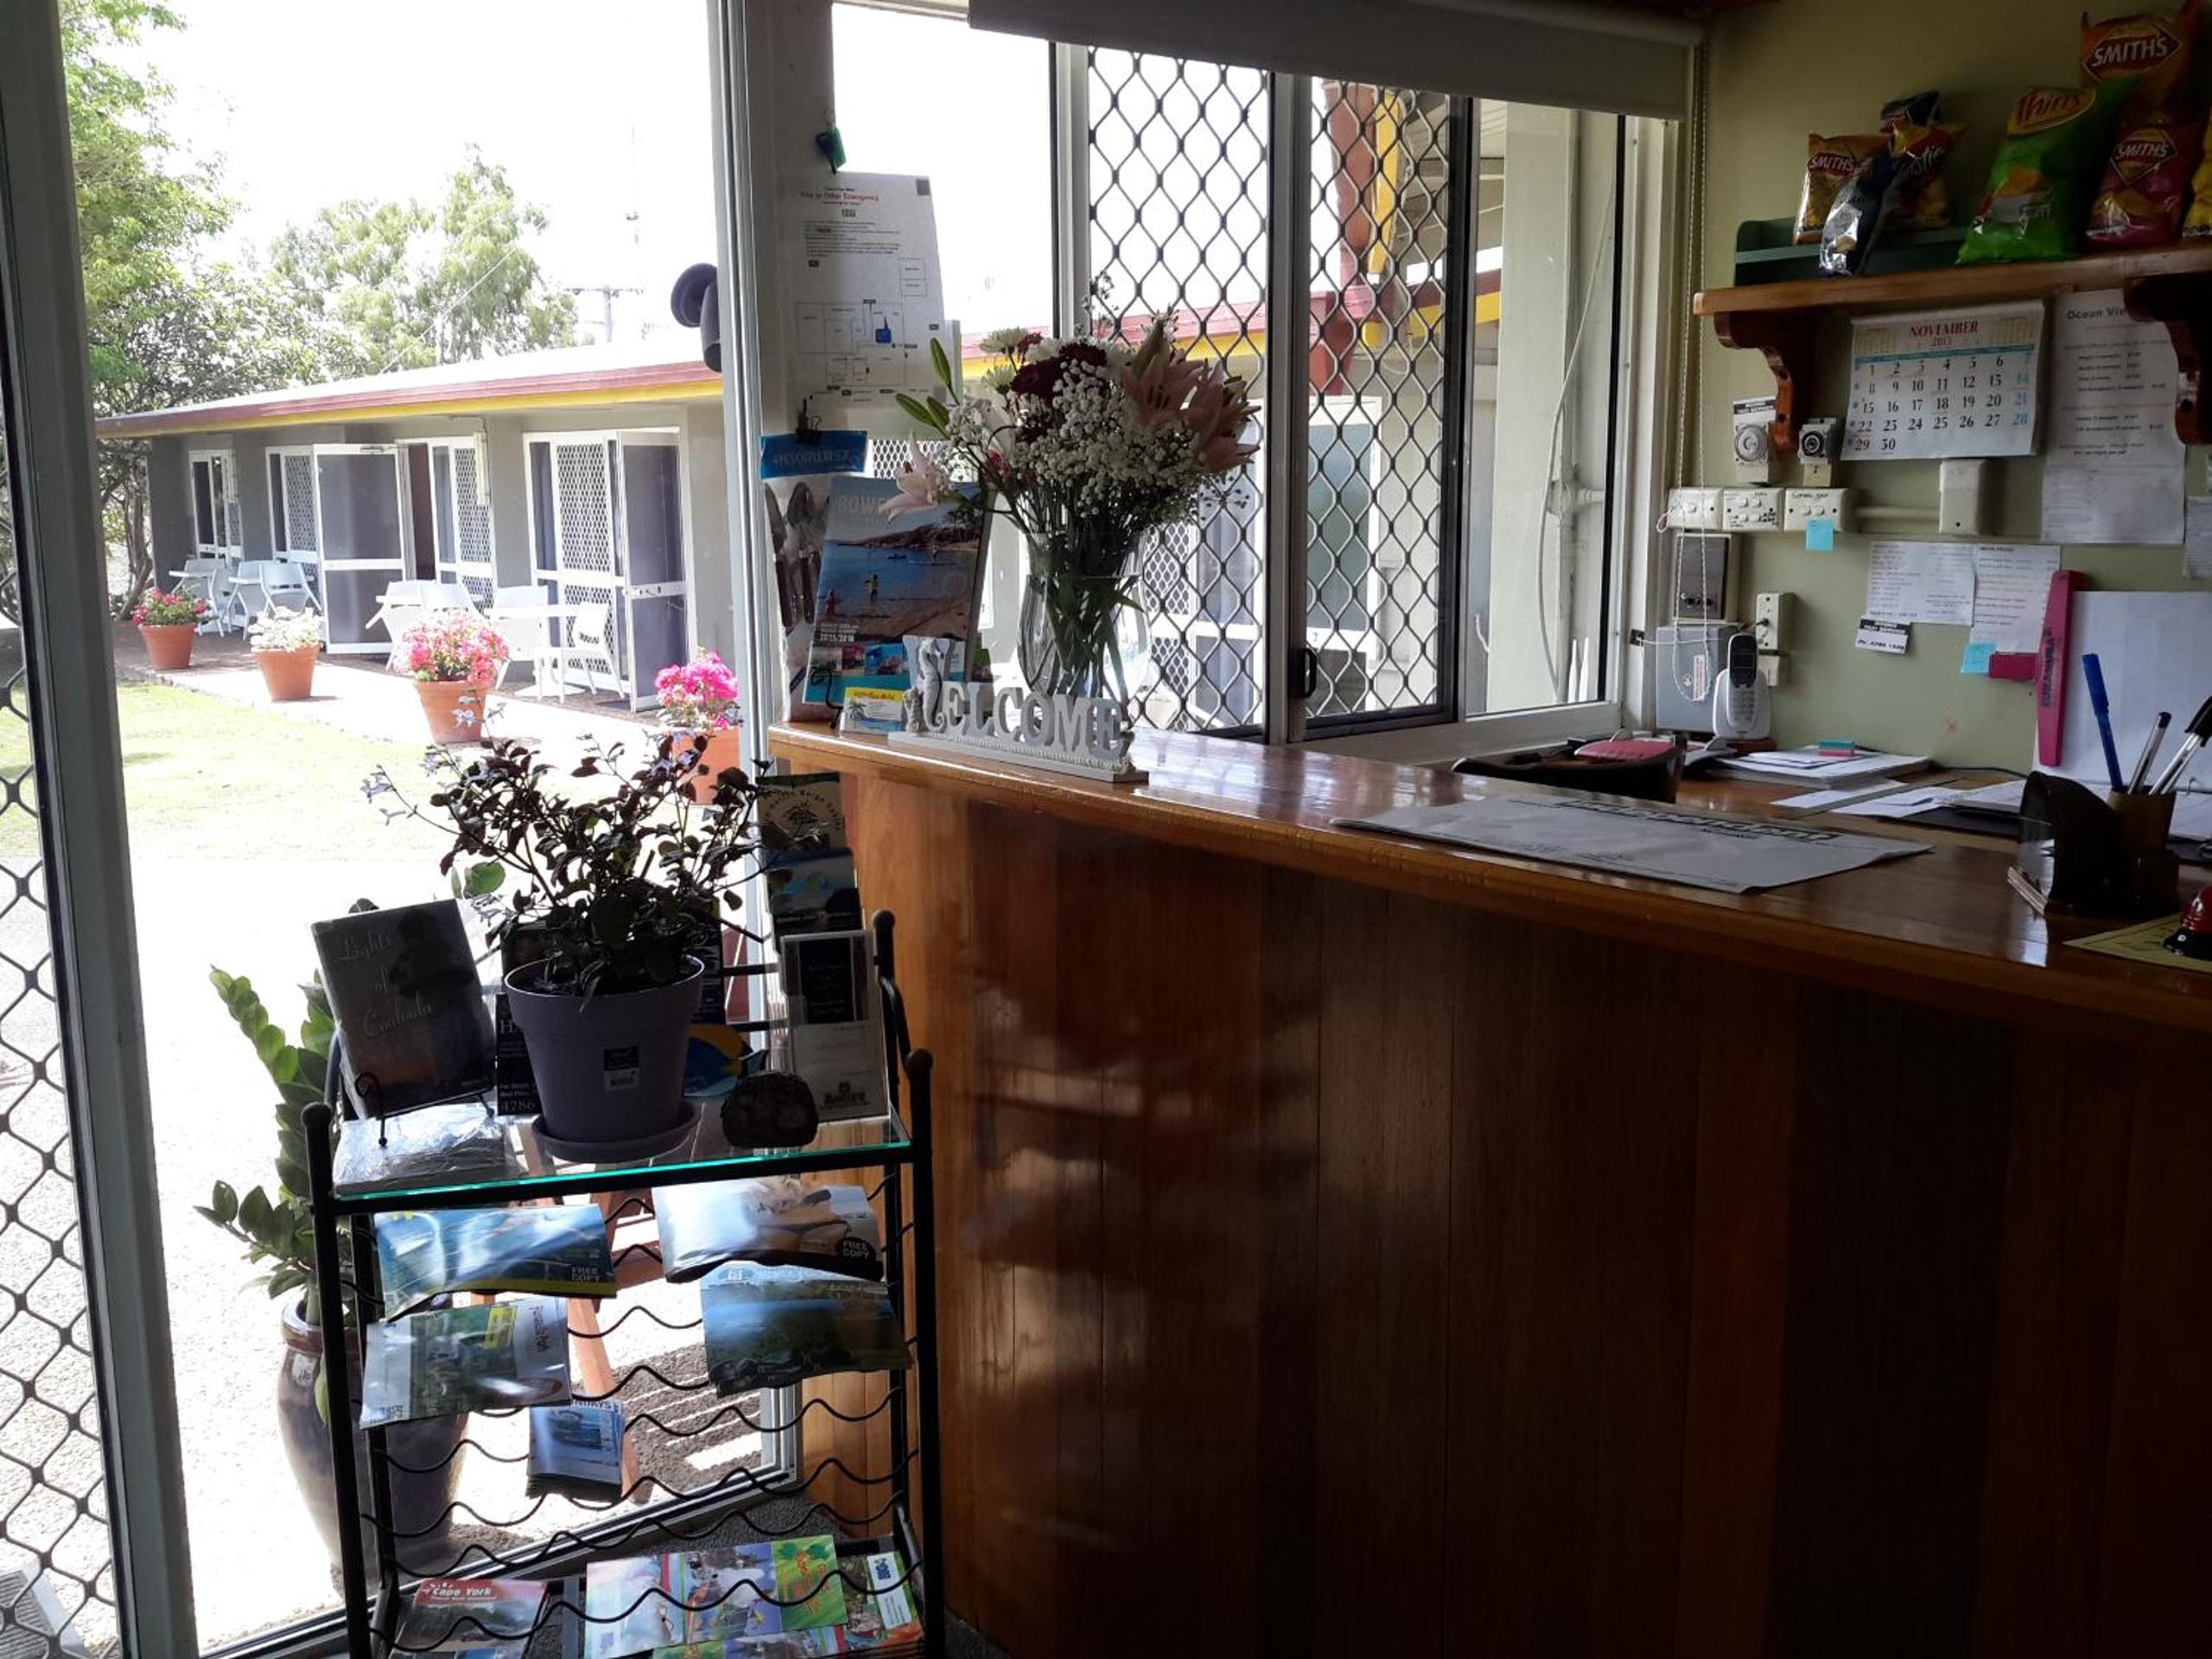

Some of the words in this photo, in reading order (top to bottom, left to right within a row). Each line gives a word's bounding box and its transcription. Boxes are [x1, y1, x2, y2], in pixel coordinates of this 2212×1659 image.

[2091, 31, 2169, 67] SMITH'S
[2115, 141, 2169, 159] SMITH'S
[2067, 308, 2104, 320] Ocean
[1909, 321, 1980, 338] NOVEMBER
[1869, 365, 1875, 375] 1
[1892, 363, 1900, 373] 2
[1943, 359, 1950, 370] 4
[1969, 357, 1976, 368] 5
[1996, 356, 2004, 366] 6
[1891, 382, 1899, 392] 9
[1912, 379, 1924, 391] 10
[1937, 378, 1948, 391] 11
[1962, 376, 1975, 389] 12
[1862, 402, 1875, 414] 15
[1887, 401, 1899, 413] 16
[1912, 399, 1923, 410] 17
[1936, 397, 1949, 410] 18
[1962, 396, 1975, 408] 19
[1986, 394, 2002, 407] 20
[1858, 421, 1872, 432] 22
[1908, 418, 1923, 430] 24
[1934, 416, 1948, 429] 25
[1959, 416, 1974, 428] 26
[1985, 414, 2000, 427] 27
[2012, 412, 2028, 426] 28
[1855, 438, 1871, 451] 29
[903, 635, 1127, 759] WELCOME
[842, 1240, 869, 1252] FREE
[842, 1248, 870, 1260] COPY
[432, 1586, 461, 1596] Cape
[466, 1586, 493, 1596] York
